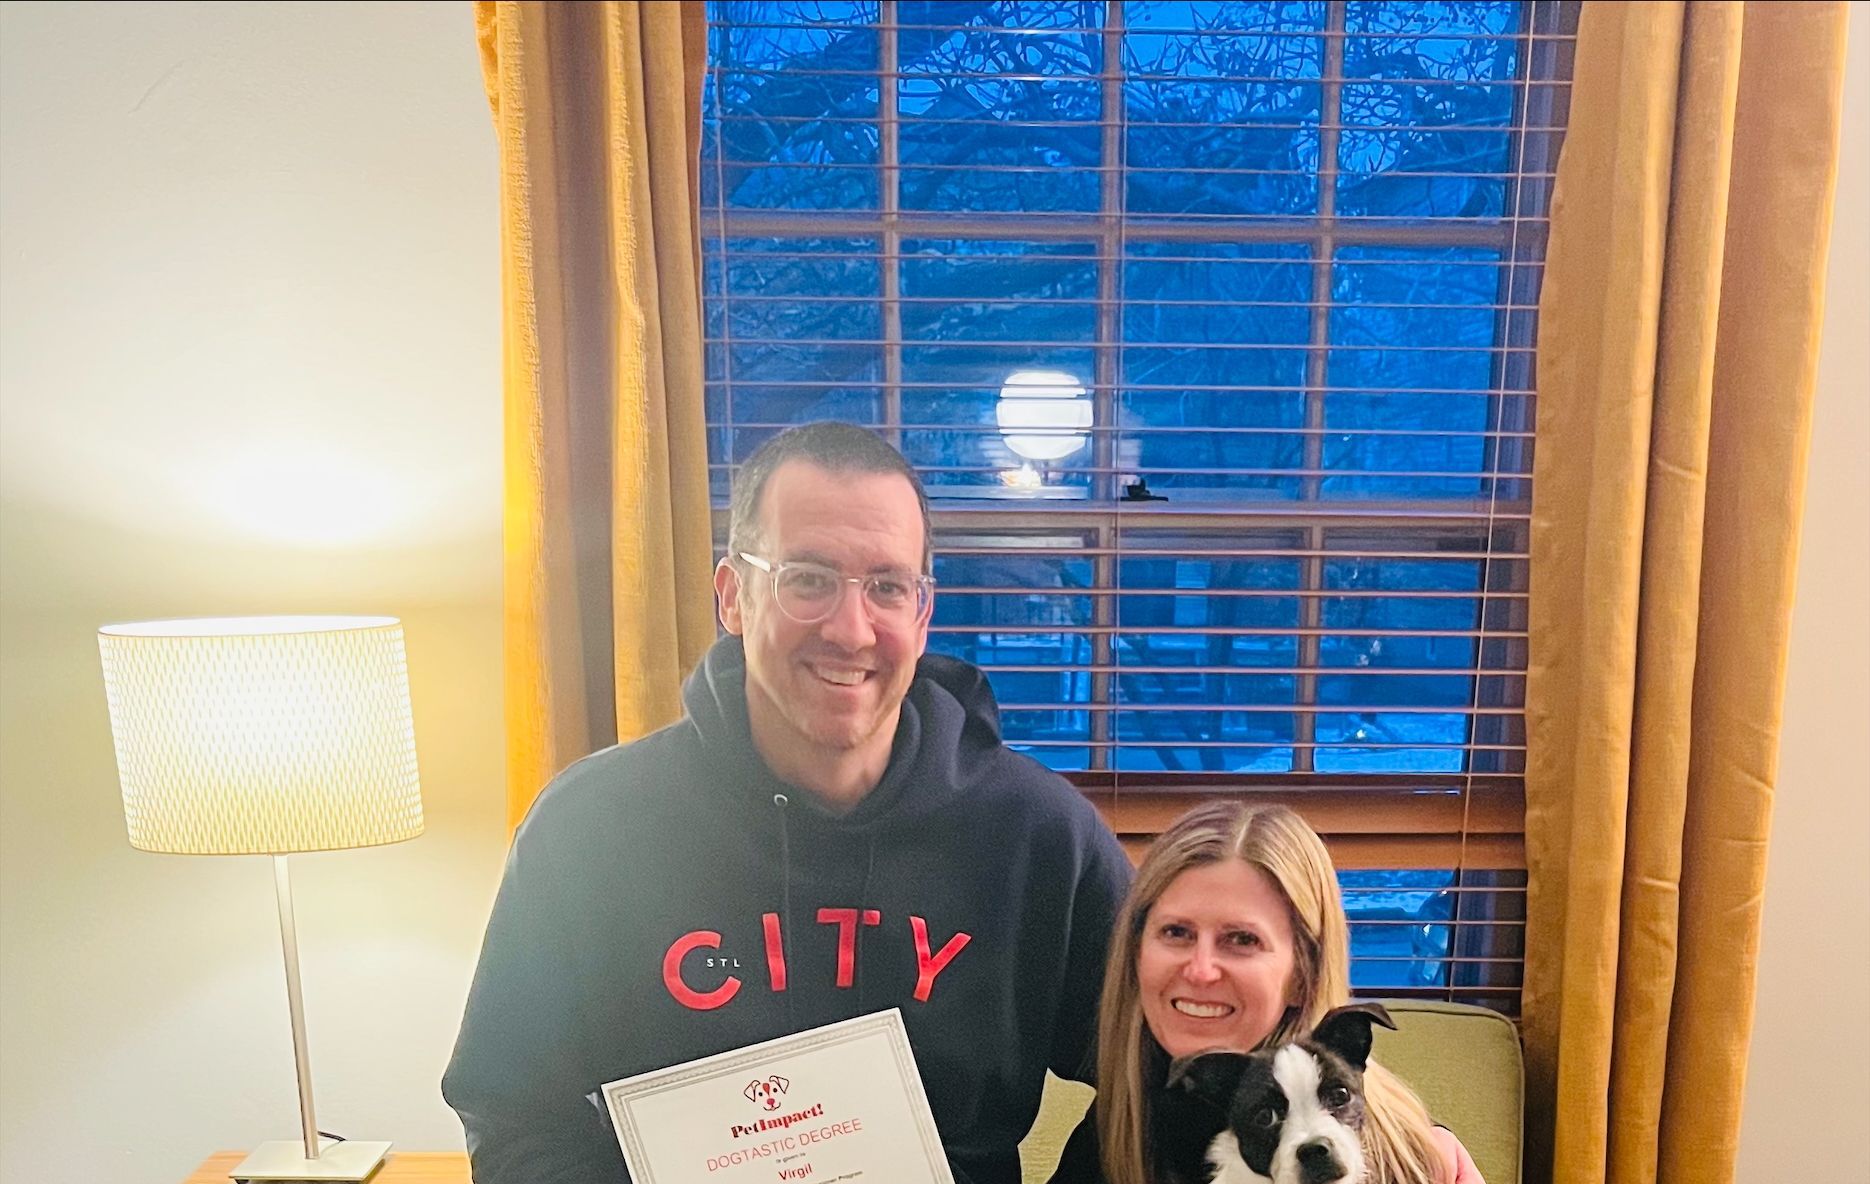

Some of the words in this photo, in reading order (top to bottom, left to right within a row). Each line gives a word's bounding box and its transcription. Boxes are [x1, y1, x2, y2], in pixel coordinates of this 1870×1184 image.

[662, 908, 972, 1010] CITY
[706, 958, 741, 968] STL
[730, 1103, 824, 1138] PetImpact!
[706, 1137, 797, 1172] DOGTASTIC
[799, 1118, 863, 1146] DEGREE
[778, 1163, 813, 1180] Virgil
[838, 1170, 863, 1180] Program
